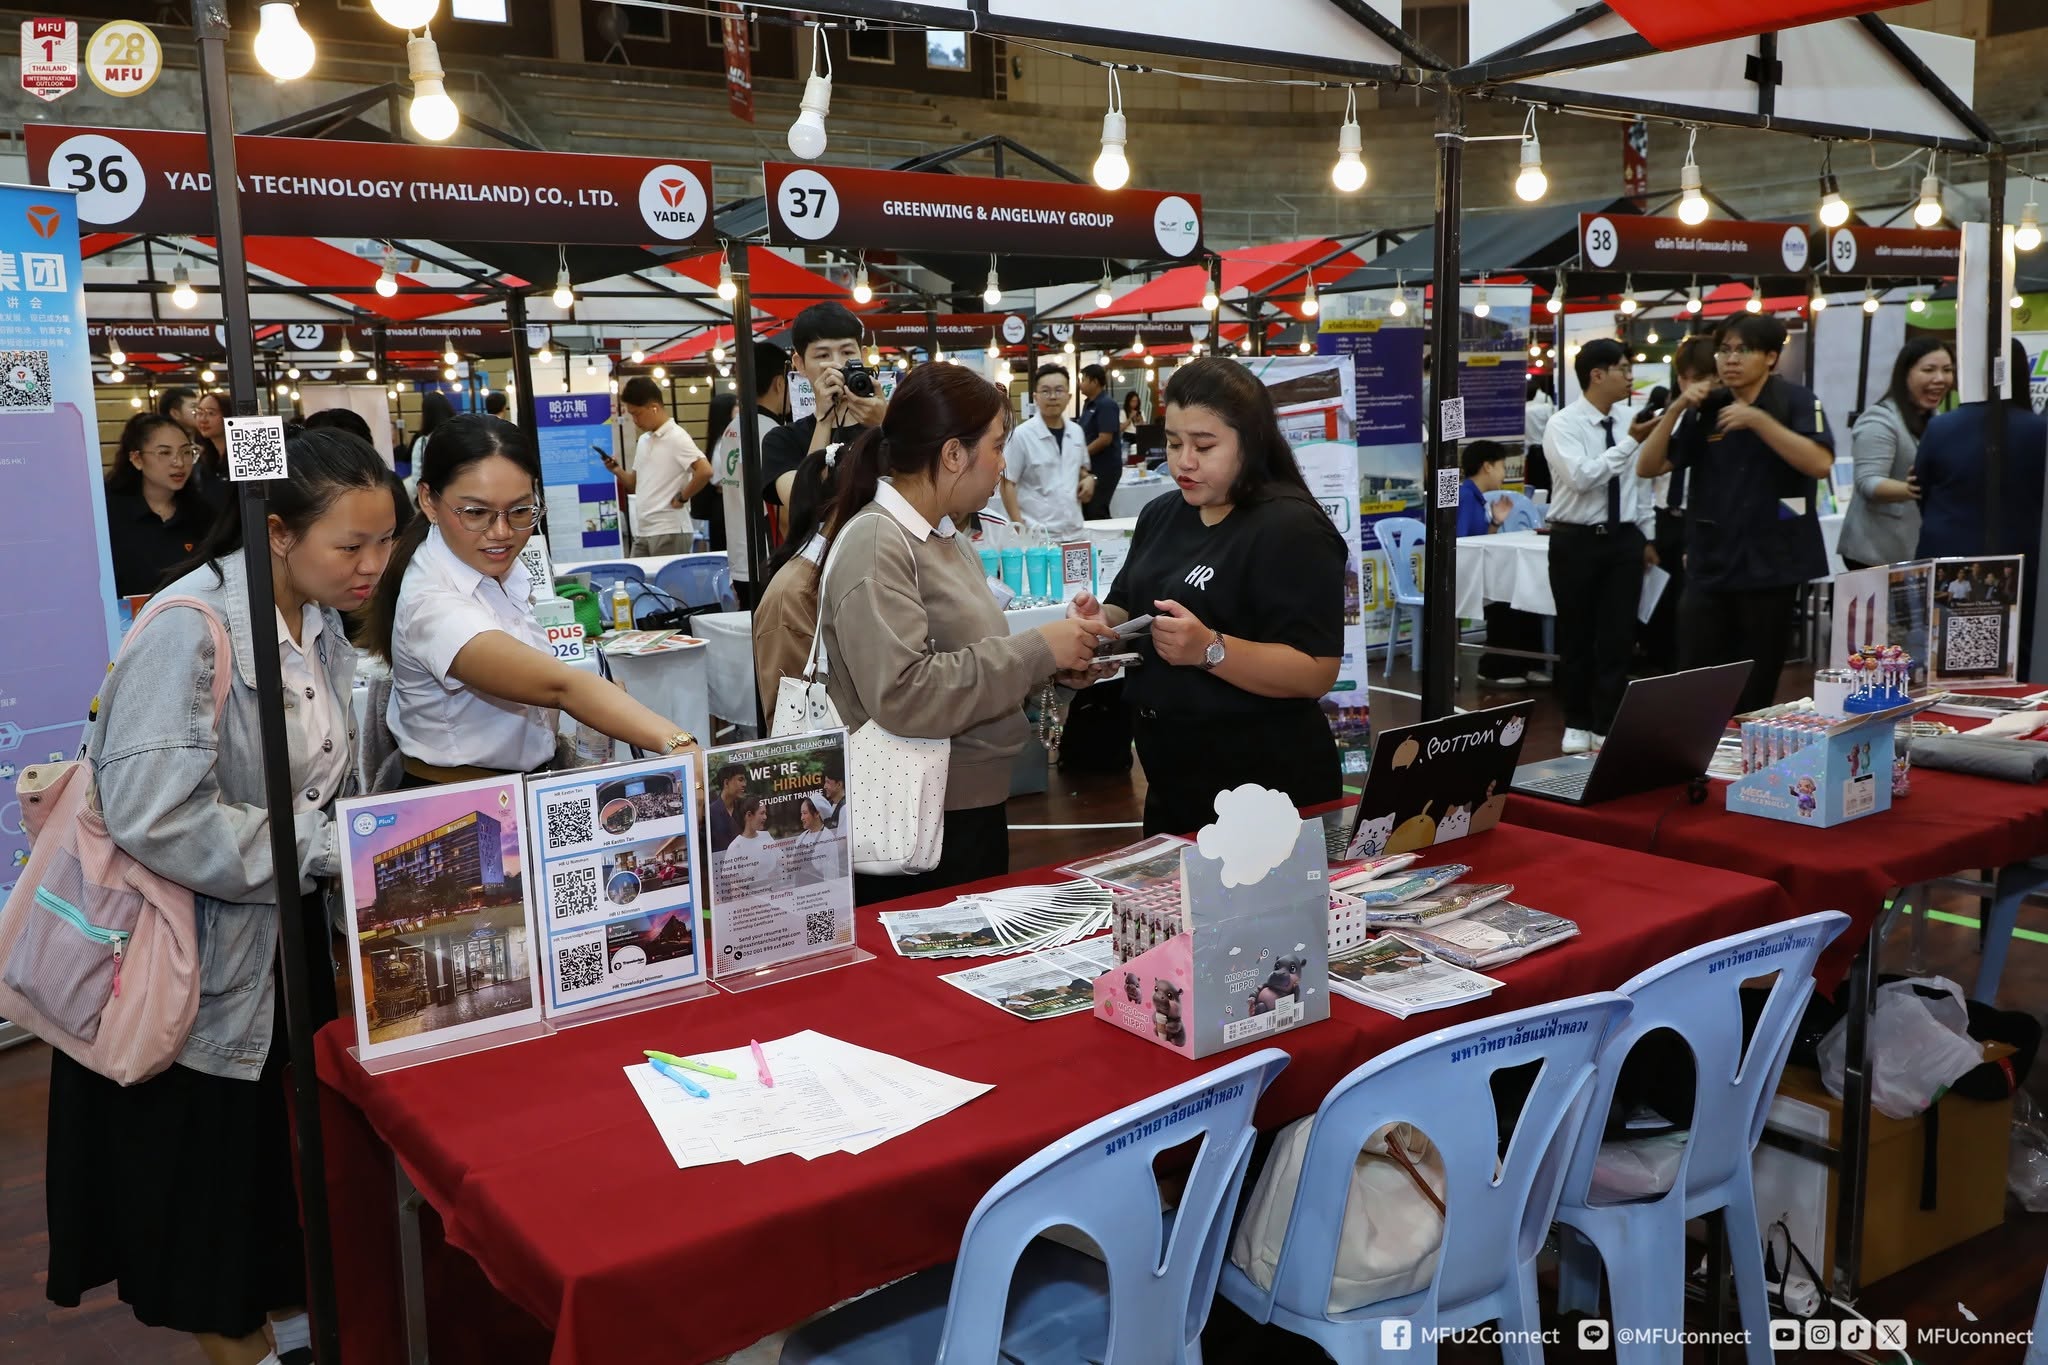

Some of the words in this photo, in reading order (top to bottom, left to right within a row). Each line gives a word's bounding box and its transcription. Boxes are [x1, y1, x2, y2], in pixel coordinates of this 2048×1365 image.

[65, 153, 128, 193] 36
[250, 175, 404, 199] TECHNOLOGY
[409, 182, 529, 206] (THAILAND)
[535, 188, 573, 208] CO.,
[579, 189, 618, 207] LTD.
[788, 188, 828, 219] 37
[653, 211, 695, 223] YADEA
[882, 200, 973, 220] GREENWING
[976, 206, 988, 220] &
[990, 207, 1066, 225] ANGELWAY
[1069, 213, 1114, 228] GROUP
[1592, 230, 1612, 251] 38
[1837, 241, 1852, 259] 39
[105, 325, 154, 337] Product
[156, 325, 210, 337] Thailand
[295, 325, 317, 339] 22
[1056, 322, 1070, 334] 24
[549, 400, 587, 414] 哈尔斯
[1184, 565, 1215, 591] HR
[728, 751, 754, 762] EASTIN
[756, 749, 770, 757] TAN
[770, 744, 793, 755] HOTEL
[796, 741, 823, 750] CHIANG
[824, 738, 837, 746] MAI
[773, 772, 823, 792] HIRING
[759, 793, 792, 807] STUDENT
[793, 788, 824, 799] TRAINEE
[763, 839, 797, 850] Department
[770, 891, 794, 900] Benefits
[752, 933, 763, 941] your
[620, 979, 645, 988] Travelodge
[645, 974, 664, 982] Nimman
[1225, 972, 1242, 983] MOO
[1243, 968, 1260, 981] Deng
[1229, 978, 1255, 993] HIPPO
[1118, 1001, 1133, 1014] MOO
[1133, 1008, 1149, 1024] Deng
[1122, 1016, 1147, 1033] HIPPO
[1451, 1017, 1589, 1064] มหาวิทยาลัยแม่ฟ้าหลวง
[1104, 1083, 1245, 1156] มหาวิทยาลัยแม่ฟ้าหลวง
